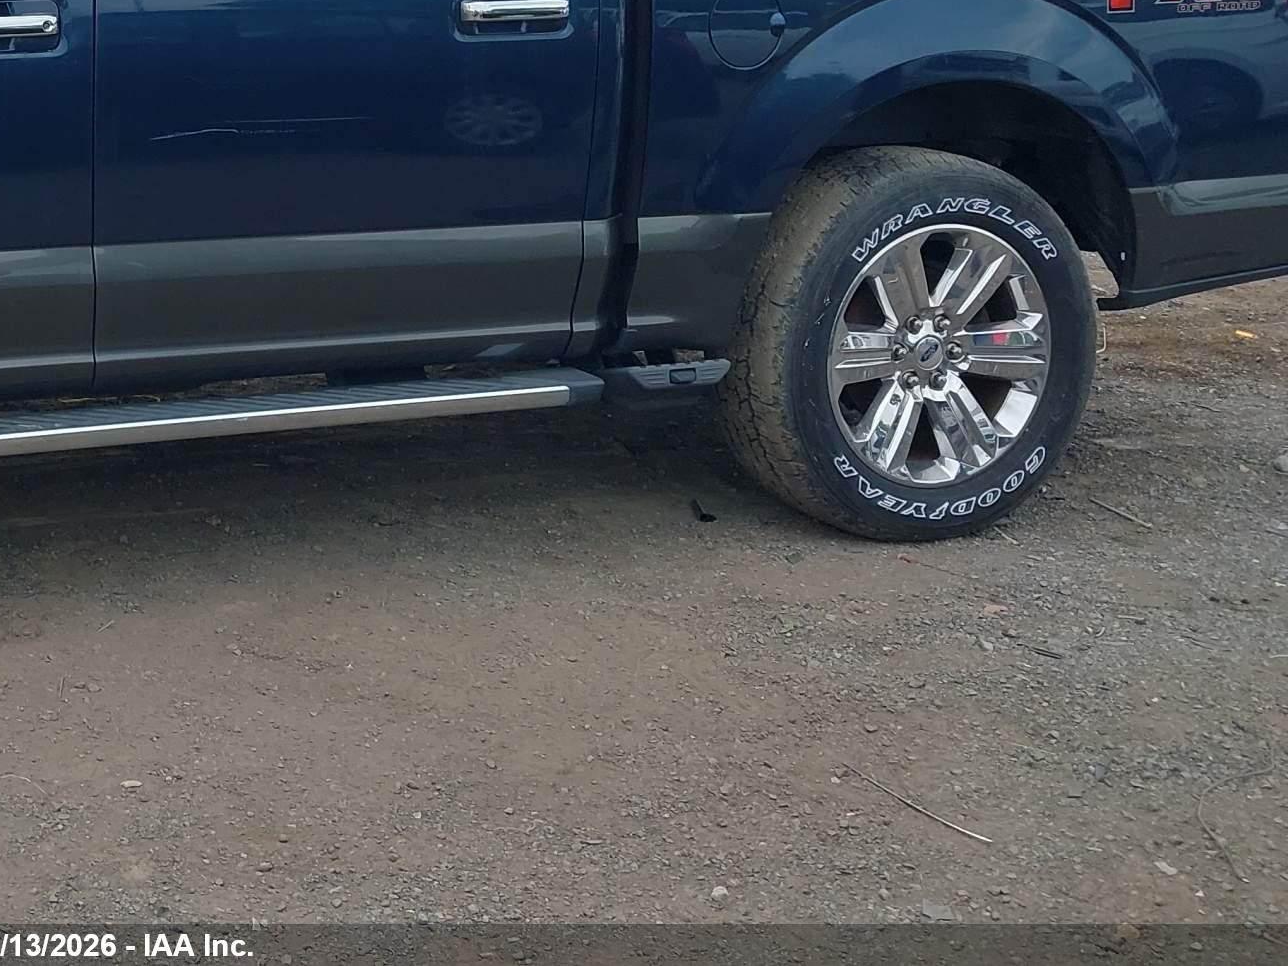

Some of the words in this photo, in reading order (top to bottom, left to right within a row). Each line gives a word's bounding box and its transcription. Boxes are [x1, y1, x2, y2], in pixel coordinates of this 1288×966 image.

[1177, 3, 1212, 13] OFF
[1216, 0, 1261, 12] ROAD
[851, 197, 1059, 263] WRANGLER
[833, 445, 1047, 521] GOODYEAR
